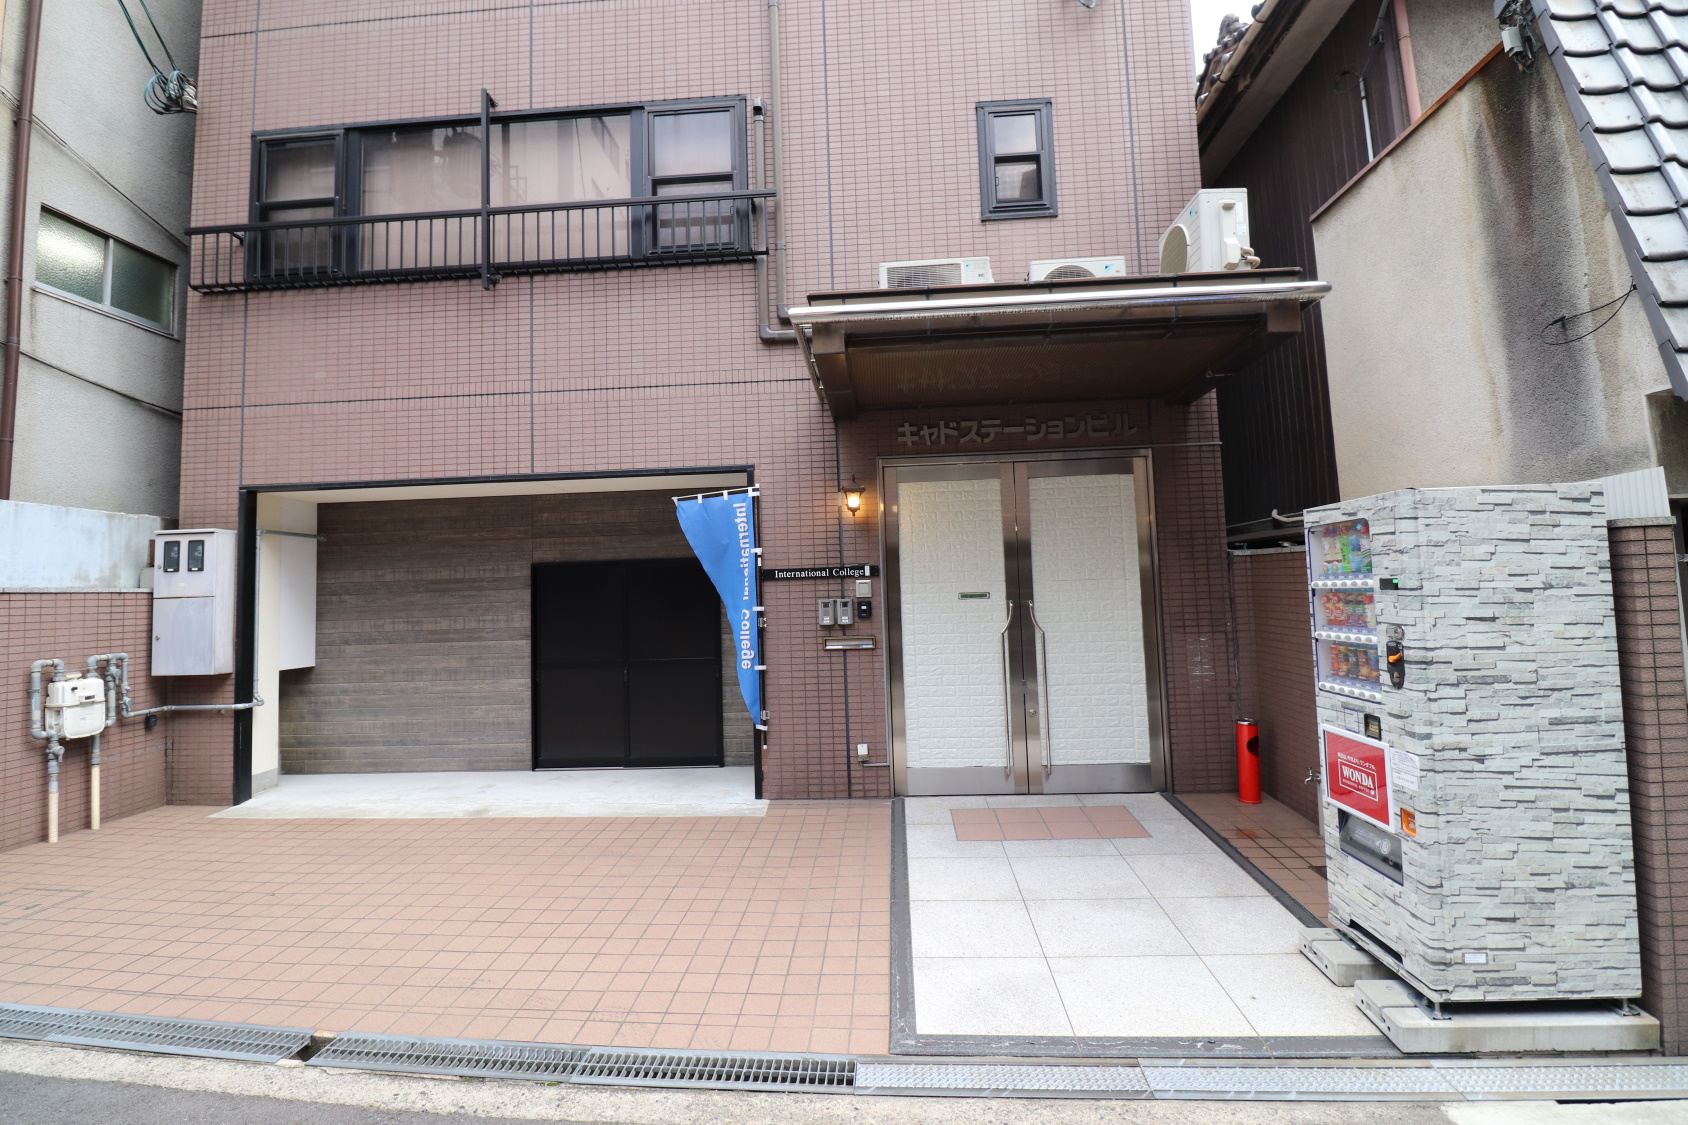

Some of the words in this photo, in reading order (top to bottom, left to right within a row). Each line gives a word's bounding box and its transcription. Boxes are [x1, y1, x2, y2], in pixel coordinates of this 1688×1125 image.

[897, 413, 1139, 447] キャドステーションビル
[774, 569, 830, 578] International
[832, 568, 864, 577] College
[1341, 765, 1374, 789] WONDA
